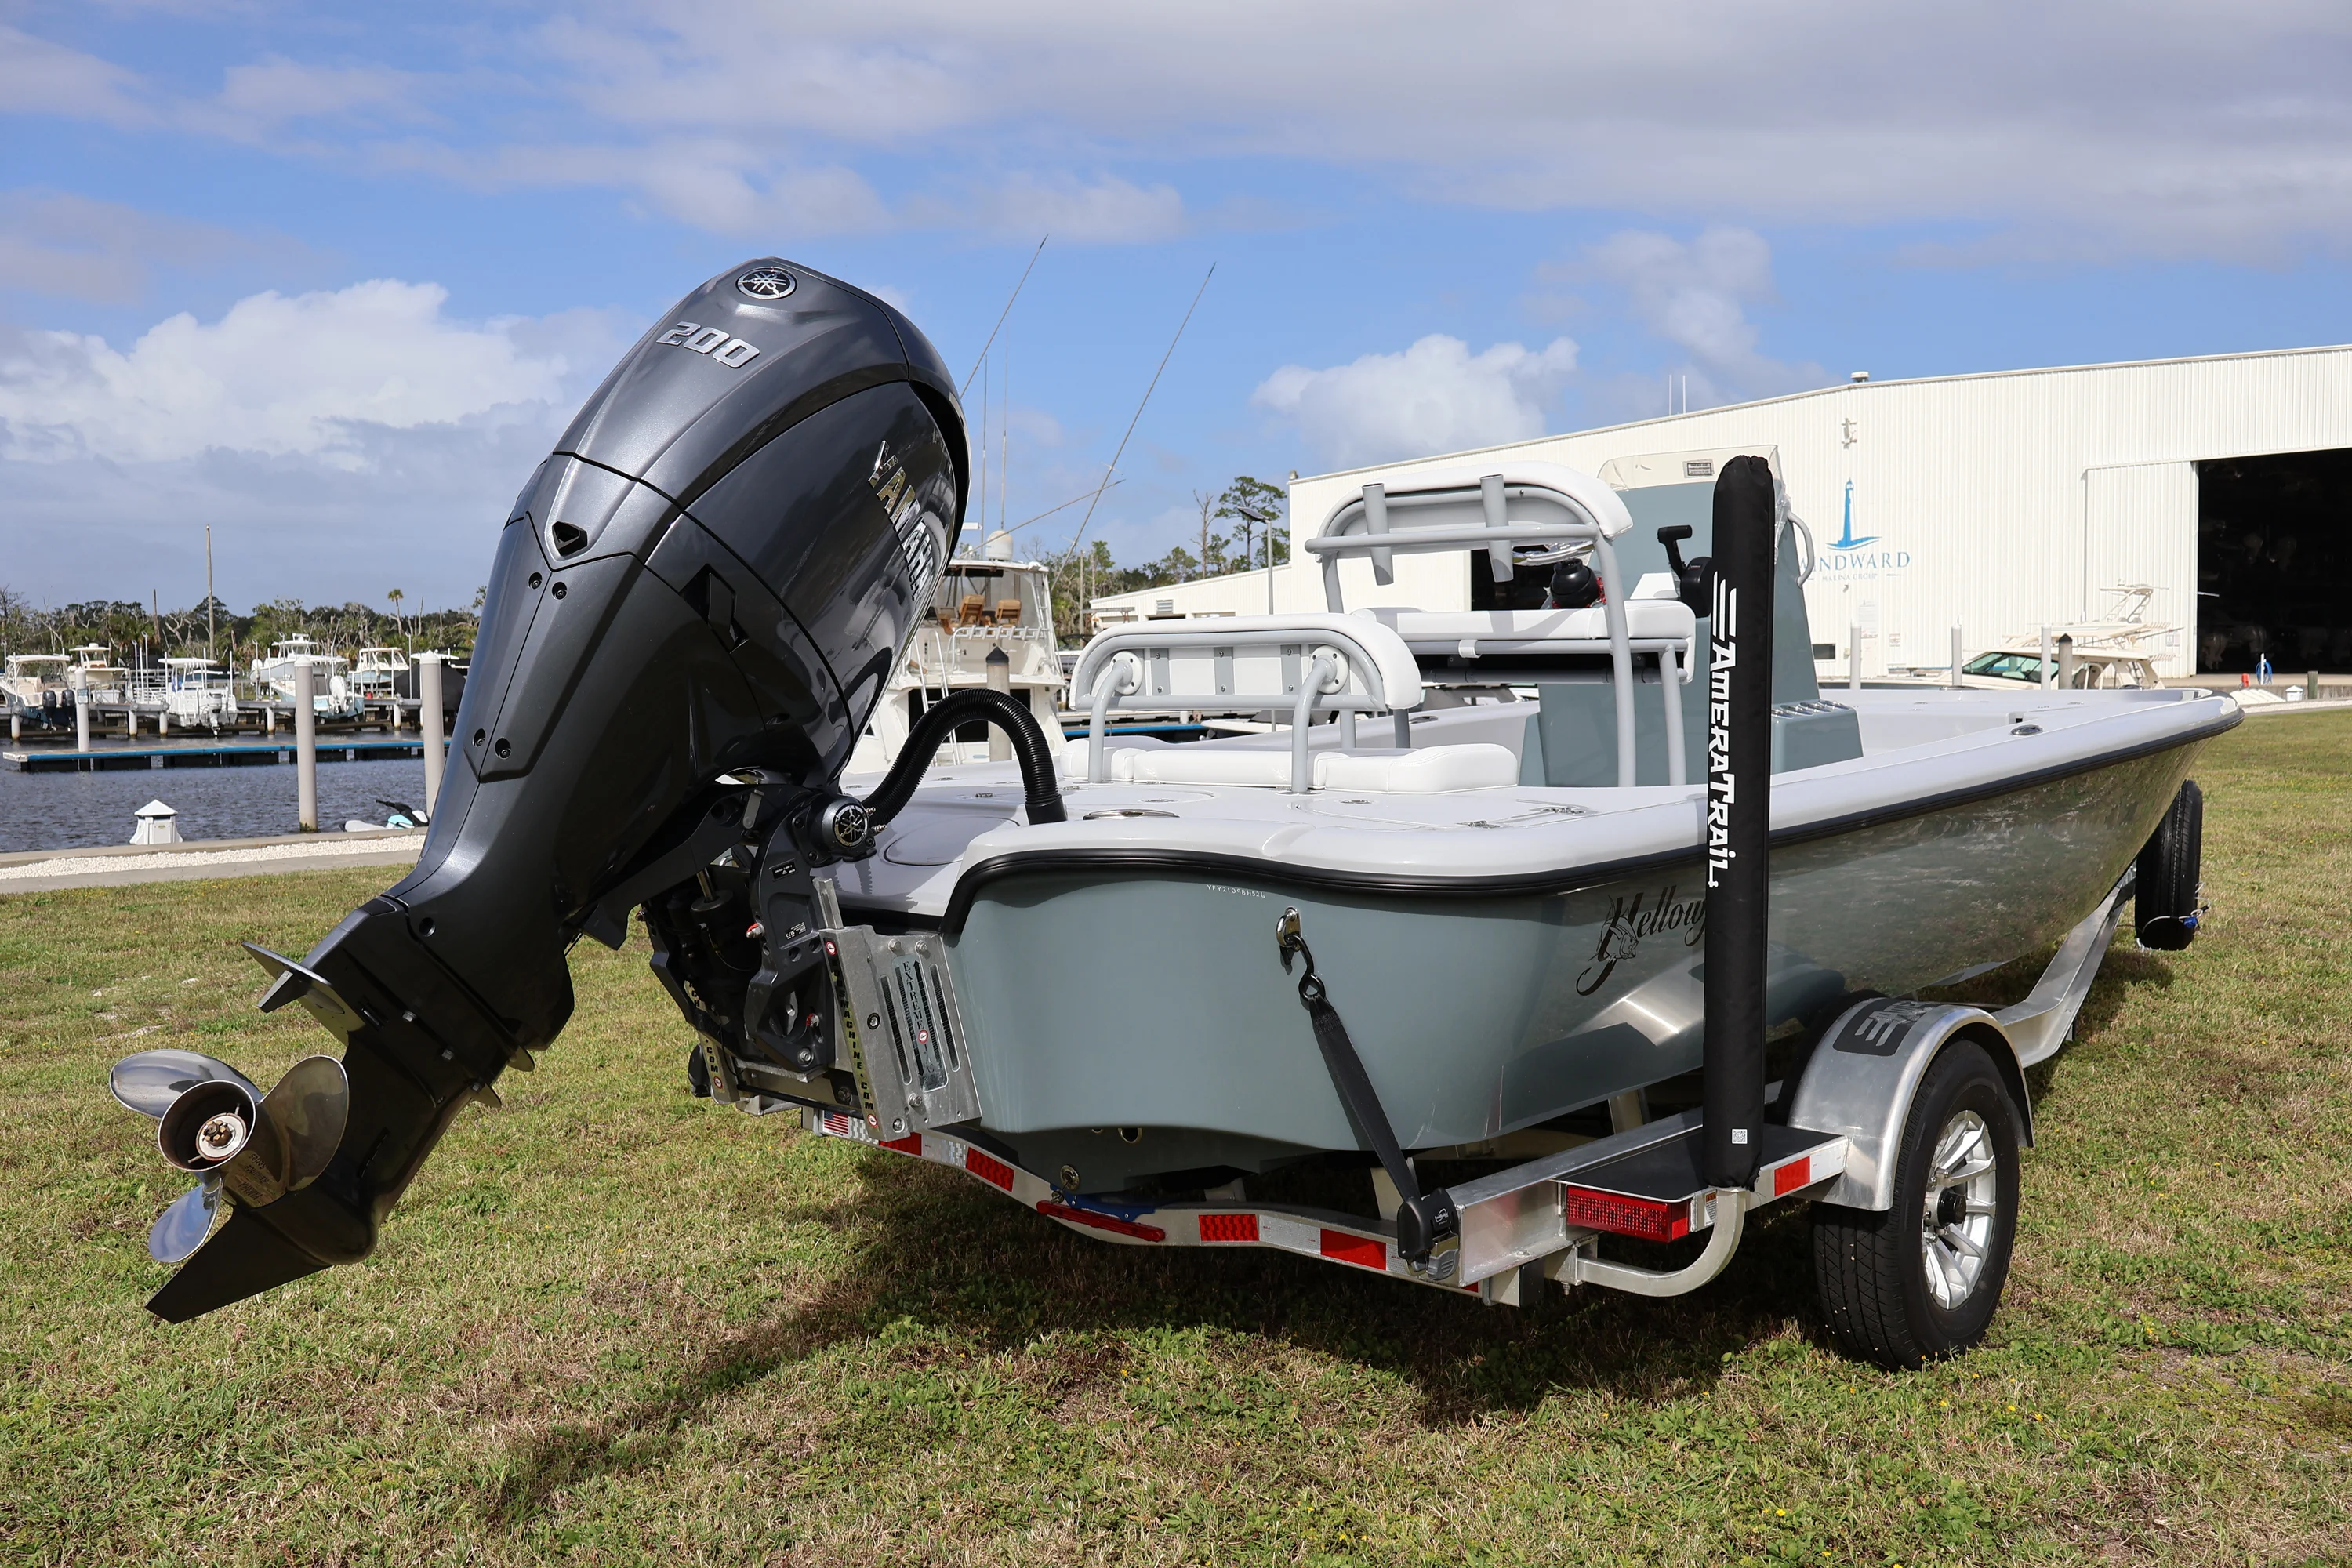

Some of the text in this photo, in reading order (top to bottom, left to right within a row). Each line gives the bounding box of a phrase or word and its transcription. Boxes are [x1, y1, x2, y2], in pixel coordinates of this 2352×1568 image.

[656, 321, 760, 369] 200
[868, 440, 934, 601] YAMAHA
[902, 961, 924, 1030] EXTREME
